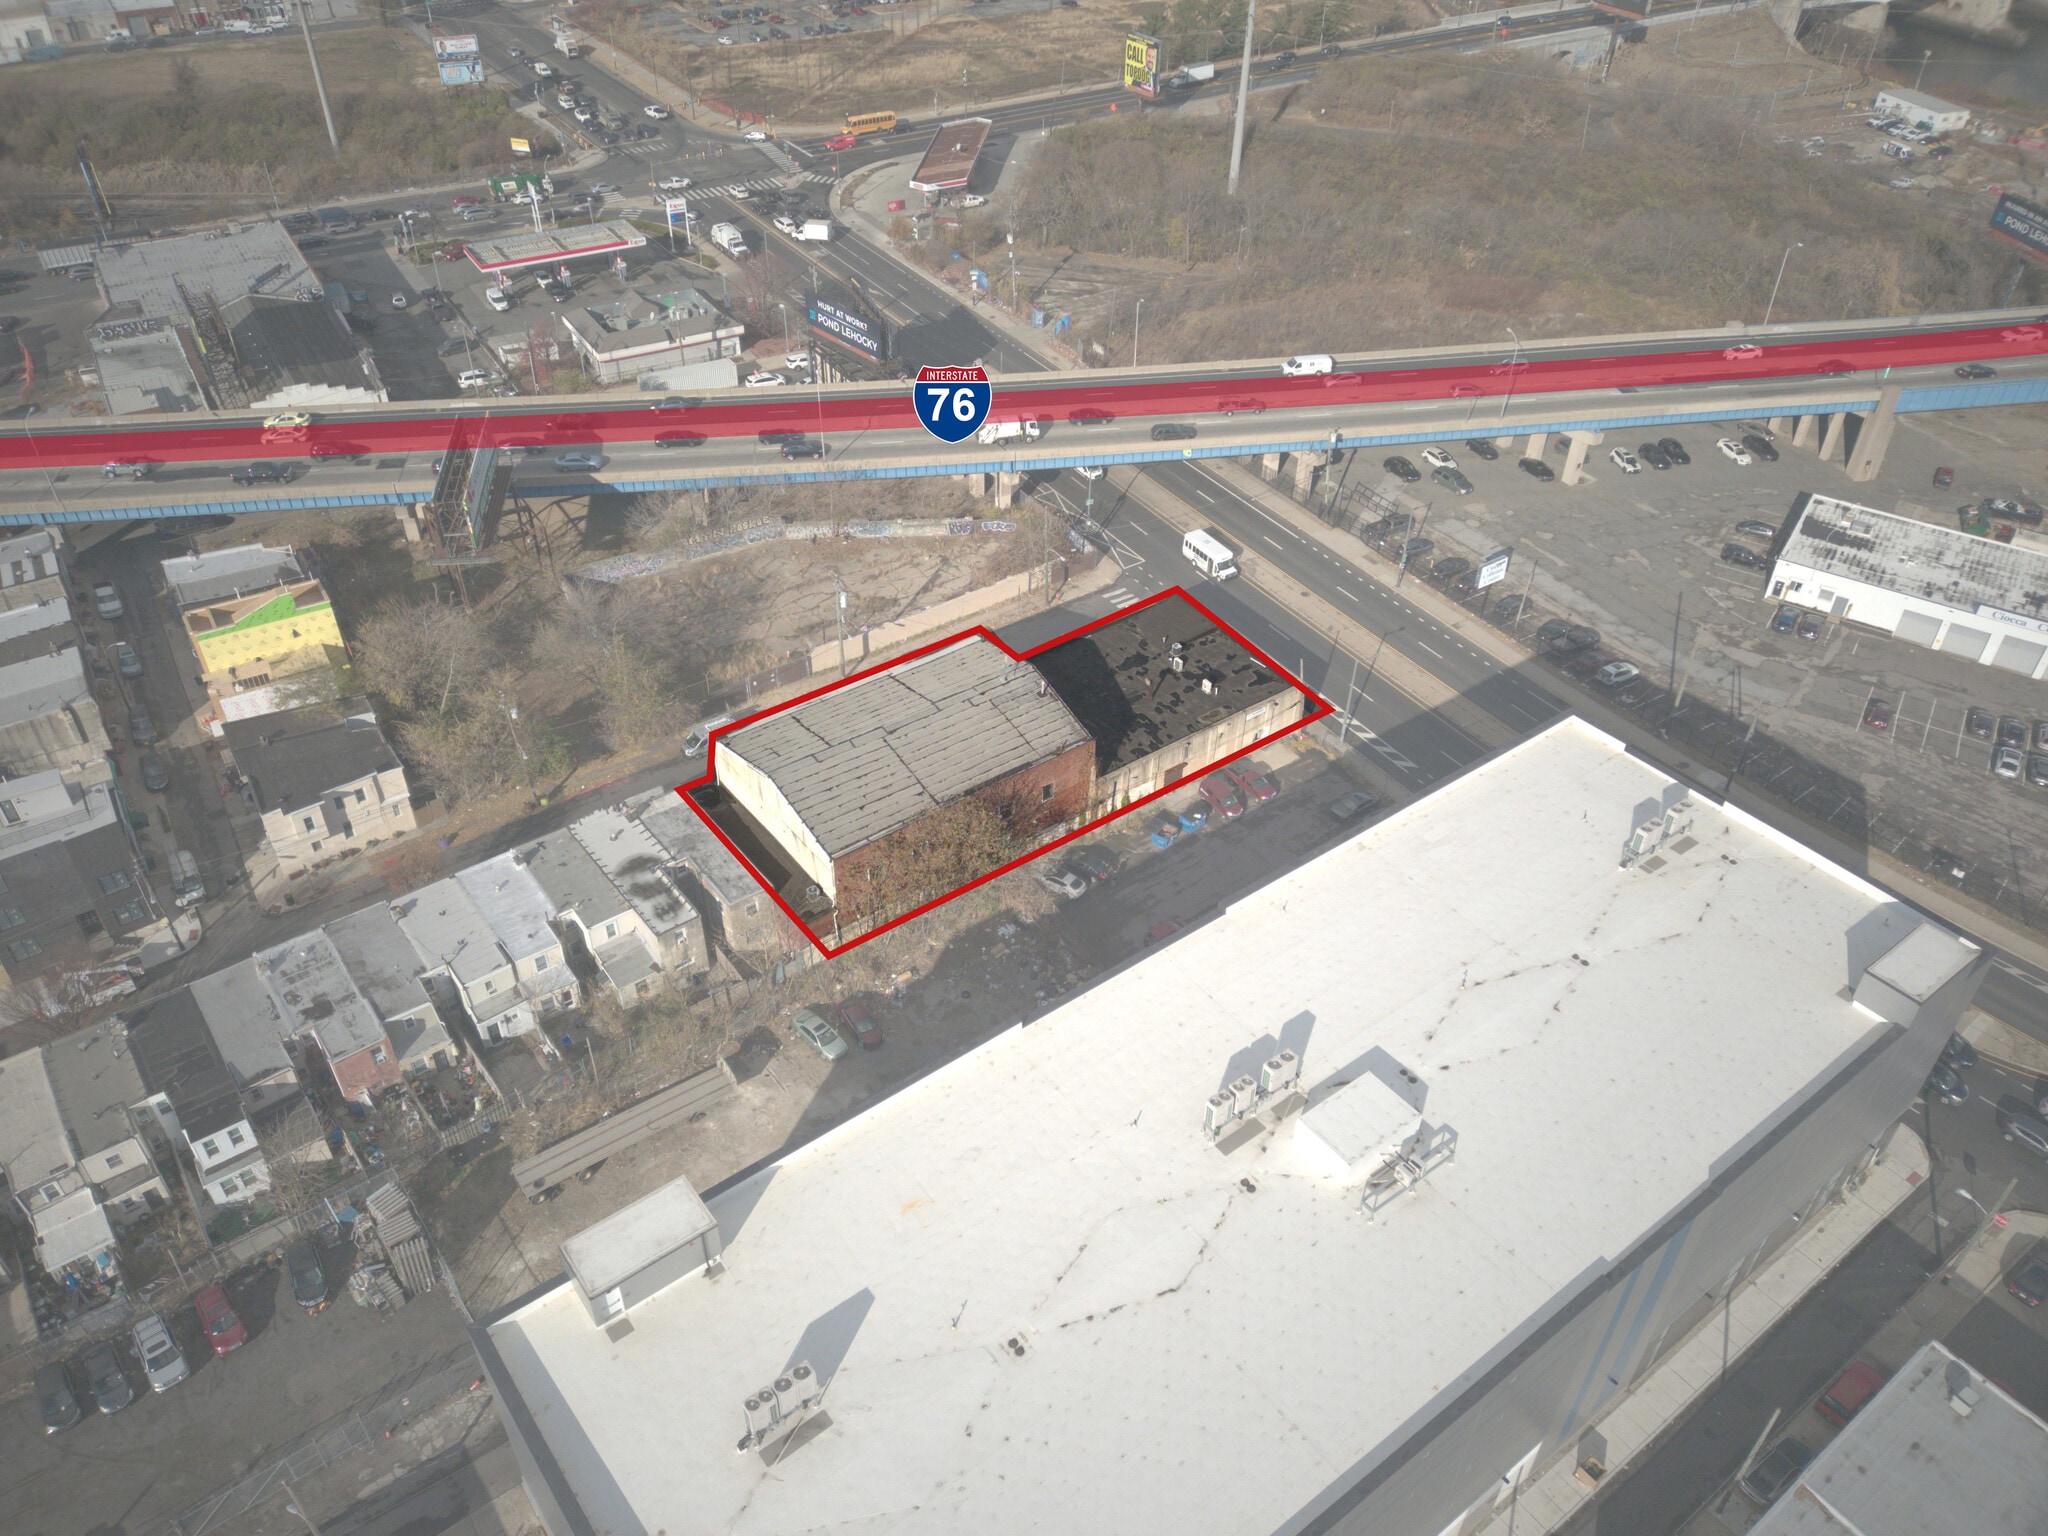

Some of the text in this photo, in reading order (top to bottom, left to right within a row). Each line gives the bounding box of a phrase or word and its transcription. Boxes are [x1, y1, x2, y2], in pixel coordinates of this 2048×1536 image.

[1127, 43, 1144, 65] CALL
[1126, 63, 1151, 84] TOPDOG
[2004, 215, 2029, 234] POND
[817, 299, 868, 331] HURT AT WORK?
[817, 313, 878, 352] POND LEHOCKY
[1992, 610, 2028, 627] Ciocca
